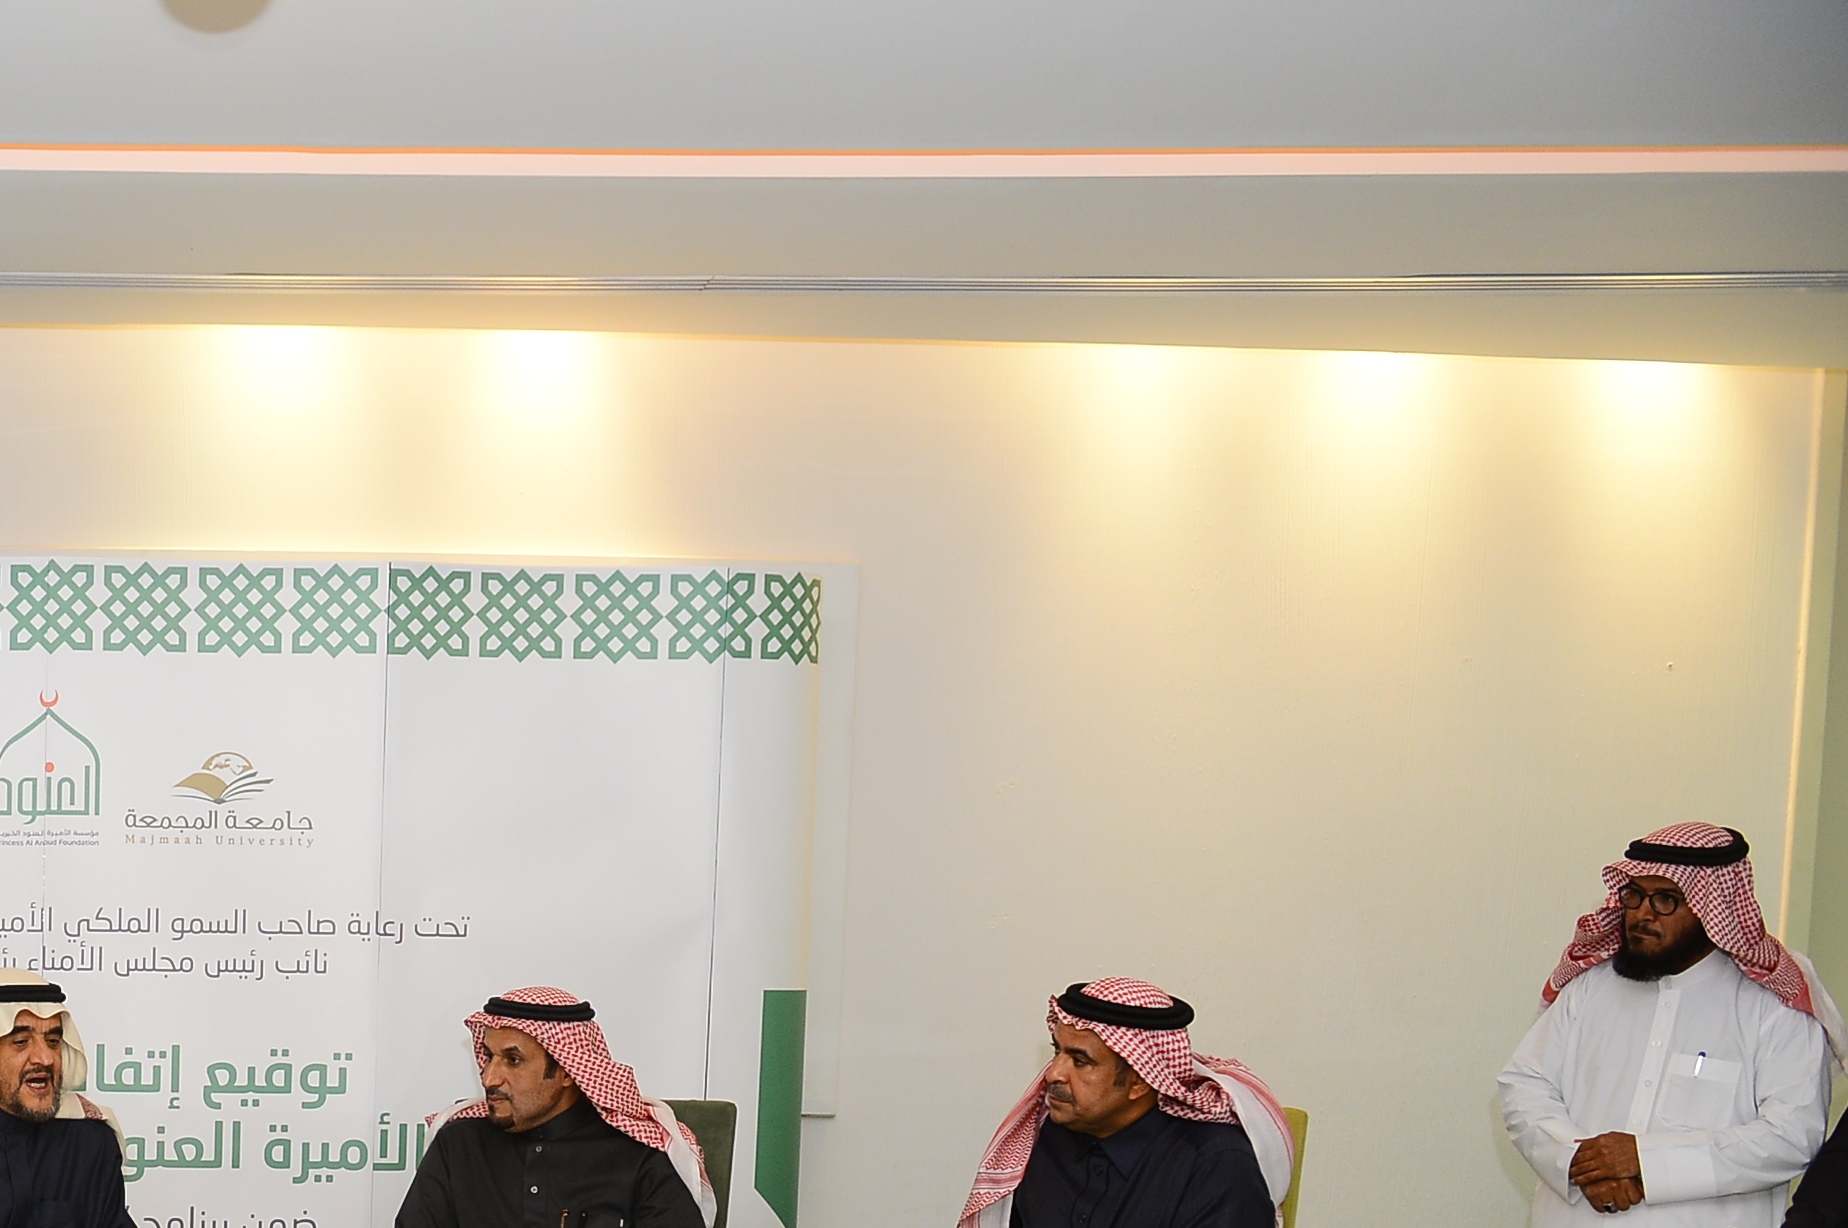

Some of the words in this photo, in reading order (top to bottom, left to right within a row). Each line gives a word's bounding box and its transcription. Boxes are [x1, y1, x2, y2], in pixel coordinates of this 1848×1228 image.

[125, 808, 218, 834] المجمعة
[225, 810, 314, 835] جامعة
[124, 834, 203, 846] Majmaah
[214, 835, 315, 848] University
[63, 906, 161, 944] الملكي
[170, 908, 248, 941] السمو
[257, 909, 337, 942] صاحب
[346, 911, 405, 945] رعاية
[414, 915, 472, 940] تحت
[26, 940, 104, 973] الأمناء
[113, 946, 195, 979] مجلس
[203, 948, 265, 982] رئيس
[274, 949, 329, 981] نائب
[202, 1048, 355, 1111] توقيع
[123, 1119, 242, 1184] العنو
[263, 1112, 426, 1186] الأميرة
